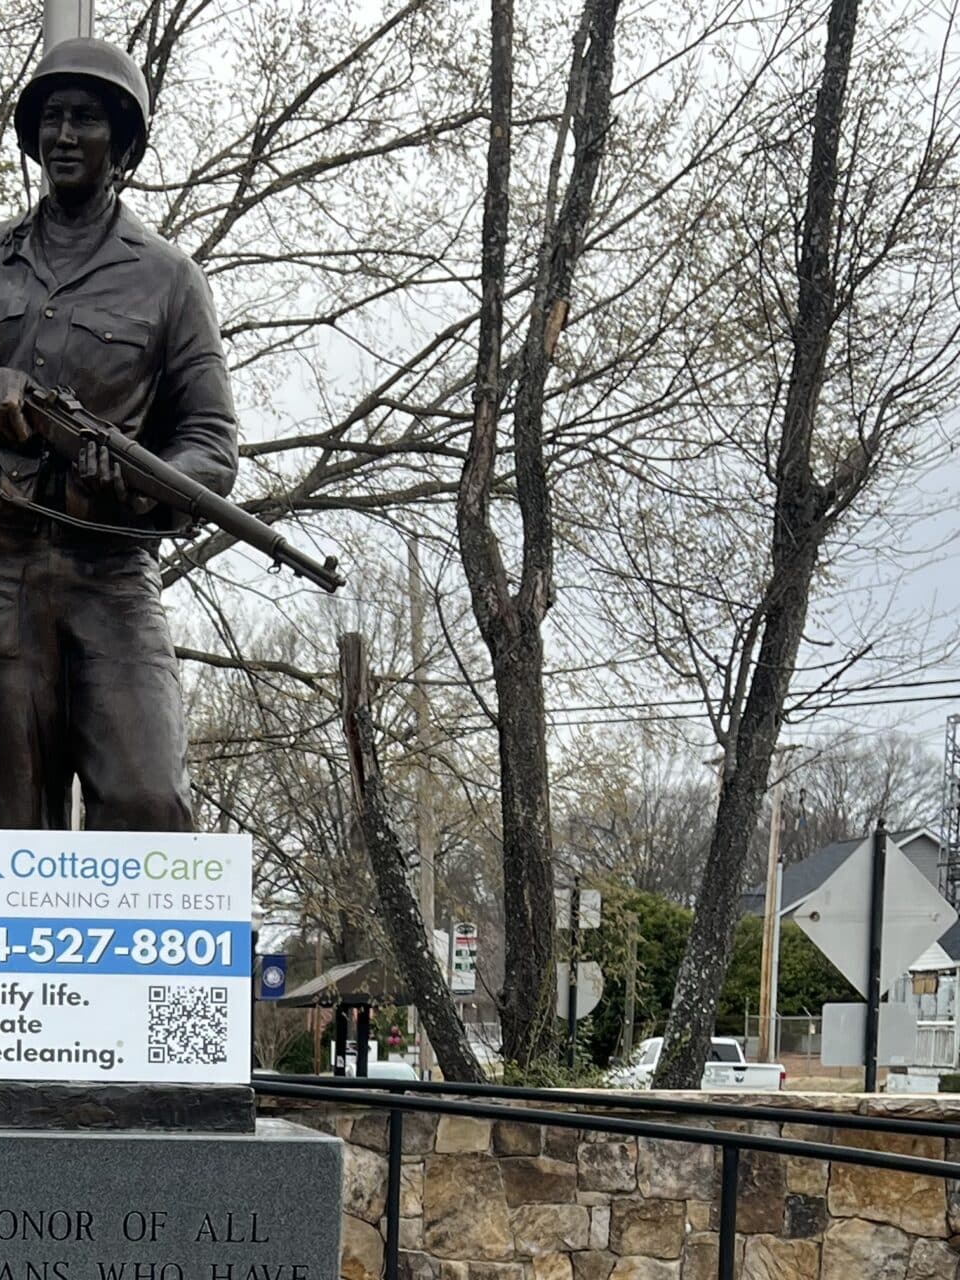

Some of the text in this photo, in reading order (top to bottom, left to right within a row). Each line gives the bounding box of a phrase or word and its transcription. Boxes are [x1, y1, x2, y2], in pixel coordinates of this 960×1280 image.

[10, 850, 223, 886] CottageCare
[6, 891, 110, 909] CLEANING
[117, 893, 140, 909] AT
[147, 893, 174, 910] ITS
[182, 894, 231, 911] BEST!
[41, 983, 90, 1007] life.
[123, 1210, 168, 1242] OF
[194, 1212, 271, 1243] ALL
